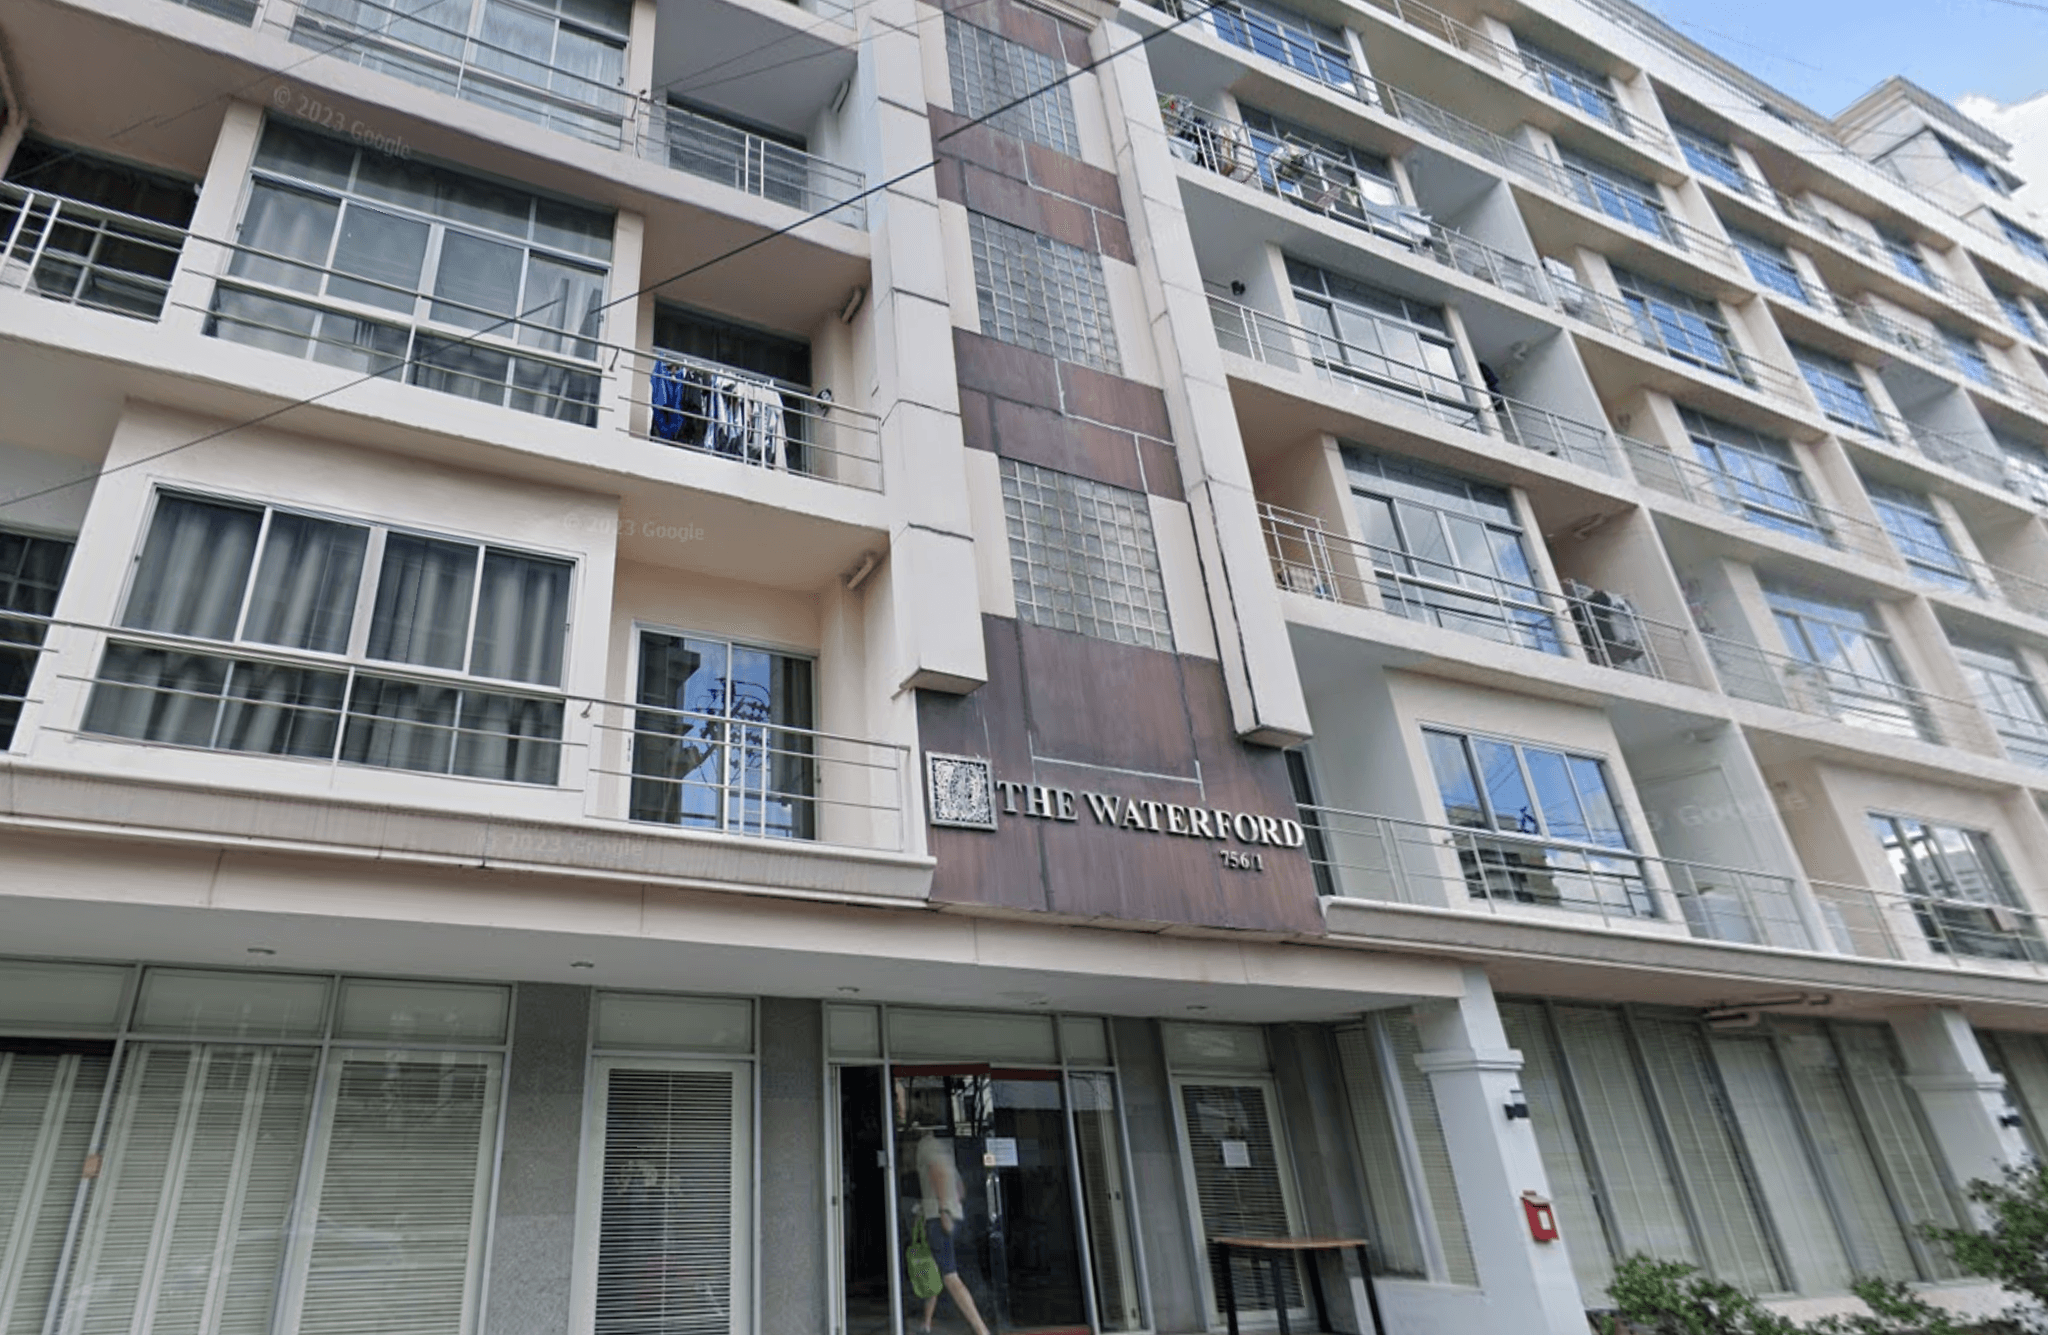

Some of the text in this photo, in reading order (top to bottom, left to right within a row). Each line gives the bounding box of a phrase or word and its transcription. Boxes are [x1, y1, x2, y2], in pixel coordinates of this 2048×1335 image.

[997, 781, 1304, 849] THE WATERFORD
[1219, 850, 1264, 871] 756/1
